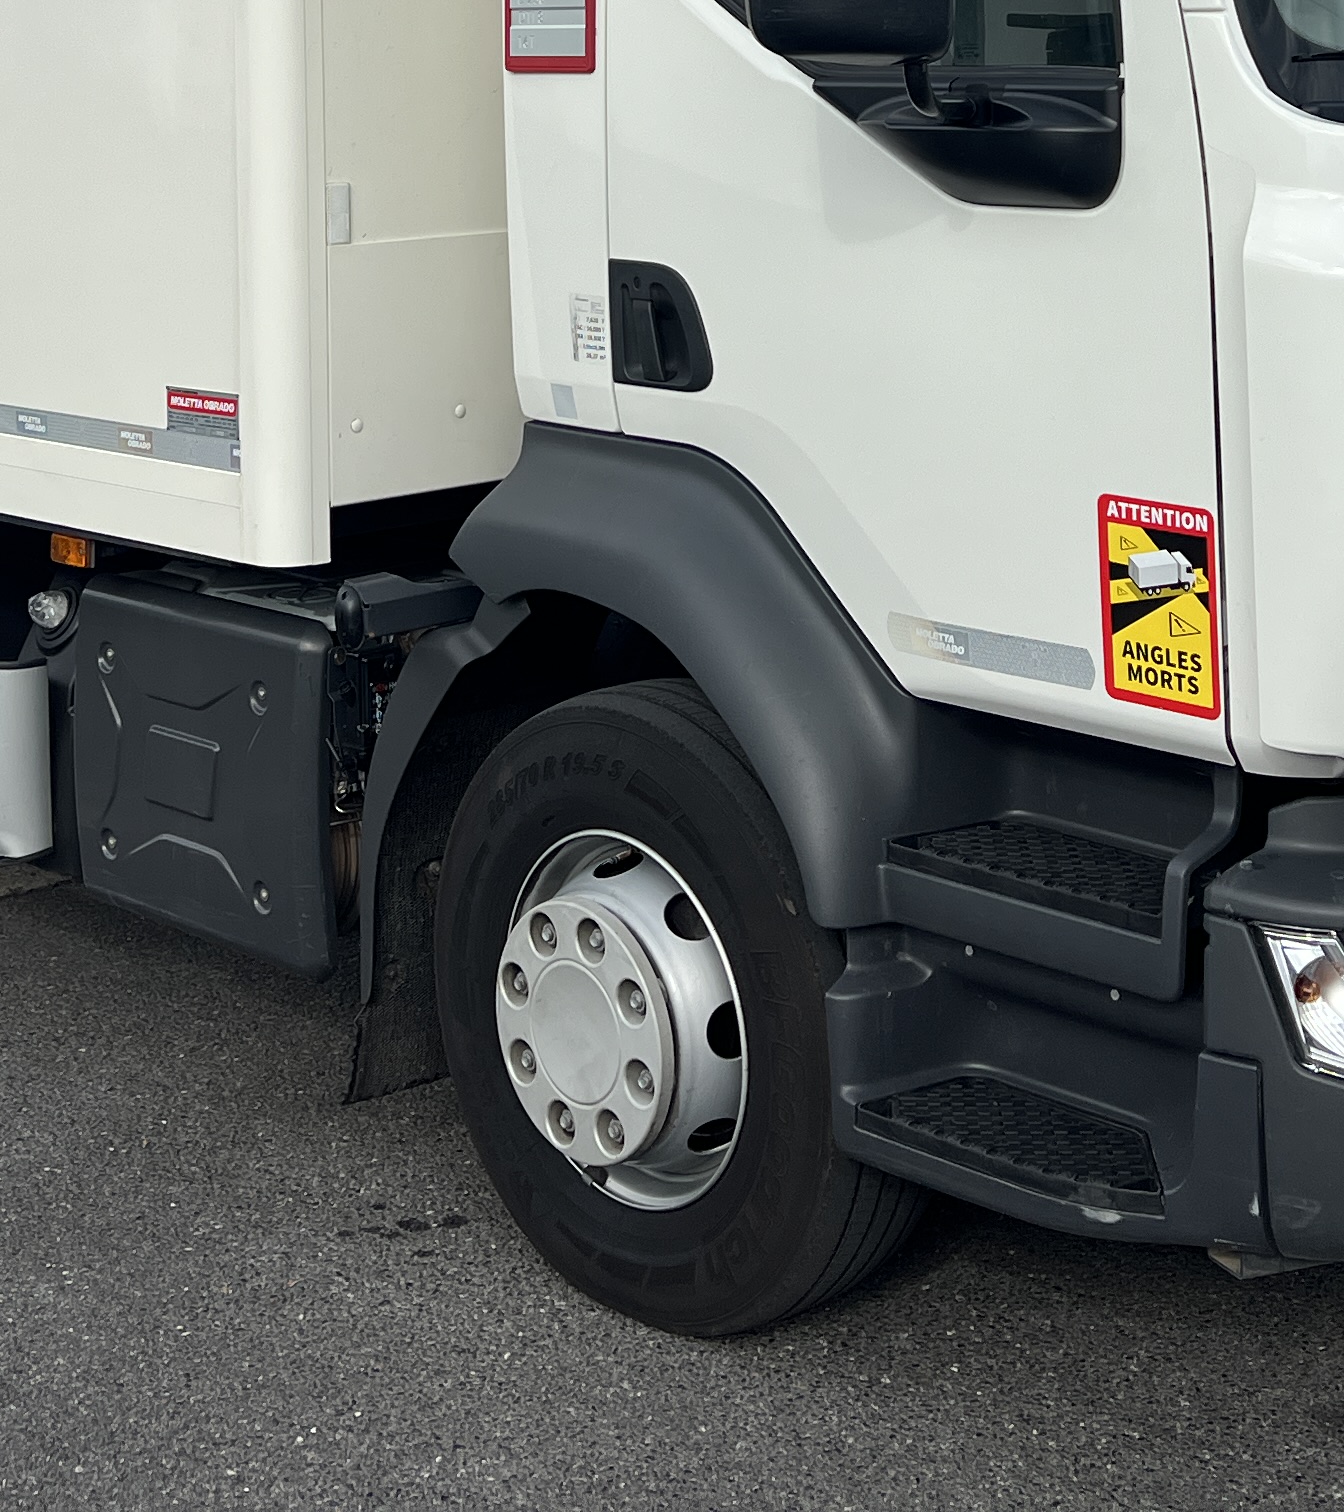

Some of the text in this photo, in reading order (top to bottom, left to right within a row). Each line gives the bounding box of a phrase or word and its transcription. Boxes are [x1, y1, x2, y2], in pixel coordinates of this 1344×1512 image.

[170, 395, 235, 414] MOLETTA OBRADO
[1106, 500, 1208, 532] ATTENTION
[916, 628, 955, 644] MOLETTA
[927, 640, 965, 656] OBRADO
[1122, 639, 1203, 673] ANGLES
[1127, 662, 1200, 696] MORTS
